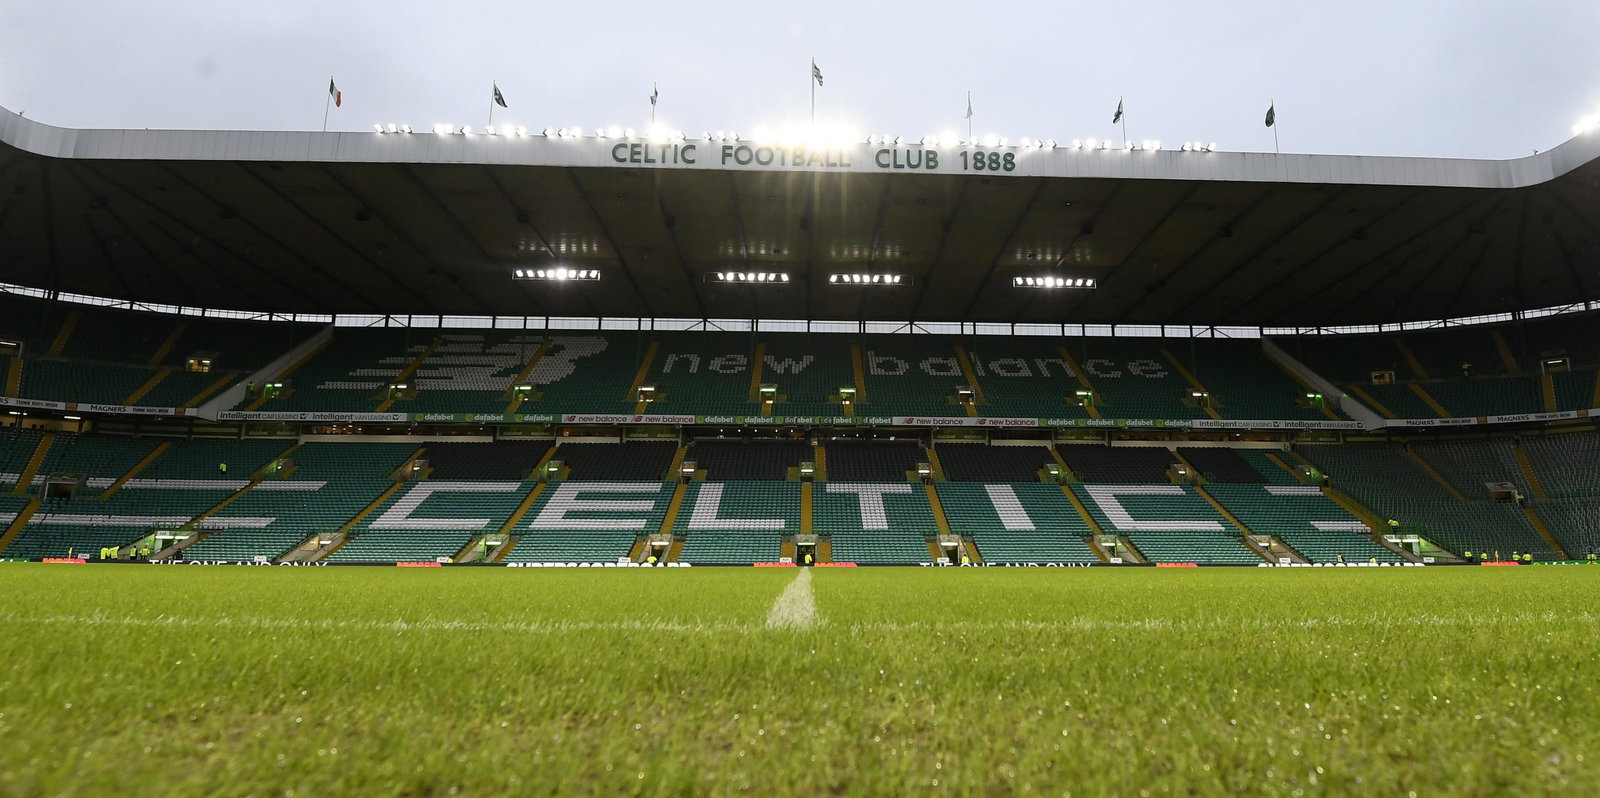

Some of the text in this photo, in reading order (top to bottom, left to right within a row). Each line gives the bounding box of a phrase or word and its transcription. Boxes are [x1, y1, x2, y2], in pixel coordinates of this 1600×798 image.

[611, 143, 1017, 172] CELTIC FOOTBALL CLUB 1888
[662, 351, 1169, 379] new balance
[90, 405, 127, 413] MAGNERS
[220, 412, 261, 421] intelligent
[312, 412, 353, 422] intelligent
[424, 413, 454, 422] dafabet
[474, 413, 504, 422] dafabet
[523, 414, 553, 422] dafabet
[595, 415, 627, 423] balance
[705, 416, 733, 424] dafabet
[744, 416, 773, 424] dafabet
[932, 417, 963, 425] balance
[1005, 418, 1036, 426] balance
[1047, 418, 1076, 427] dafabet
[1087, 418, 1115, 427] dafabet
[1126, 418, 1153, 427] dafabet
[1164, 418, 1192, 427] dafabet
[1200, 420, 1237, 429] intelligent
[1284, 420, 1322, 429] intelligent
[376, 479, 1226, 531] CELTIC
